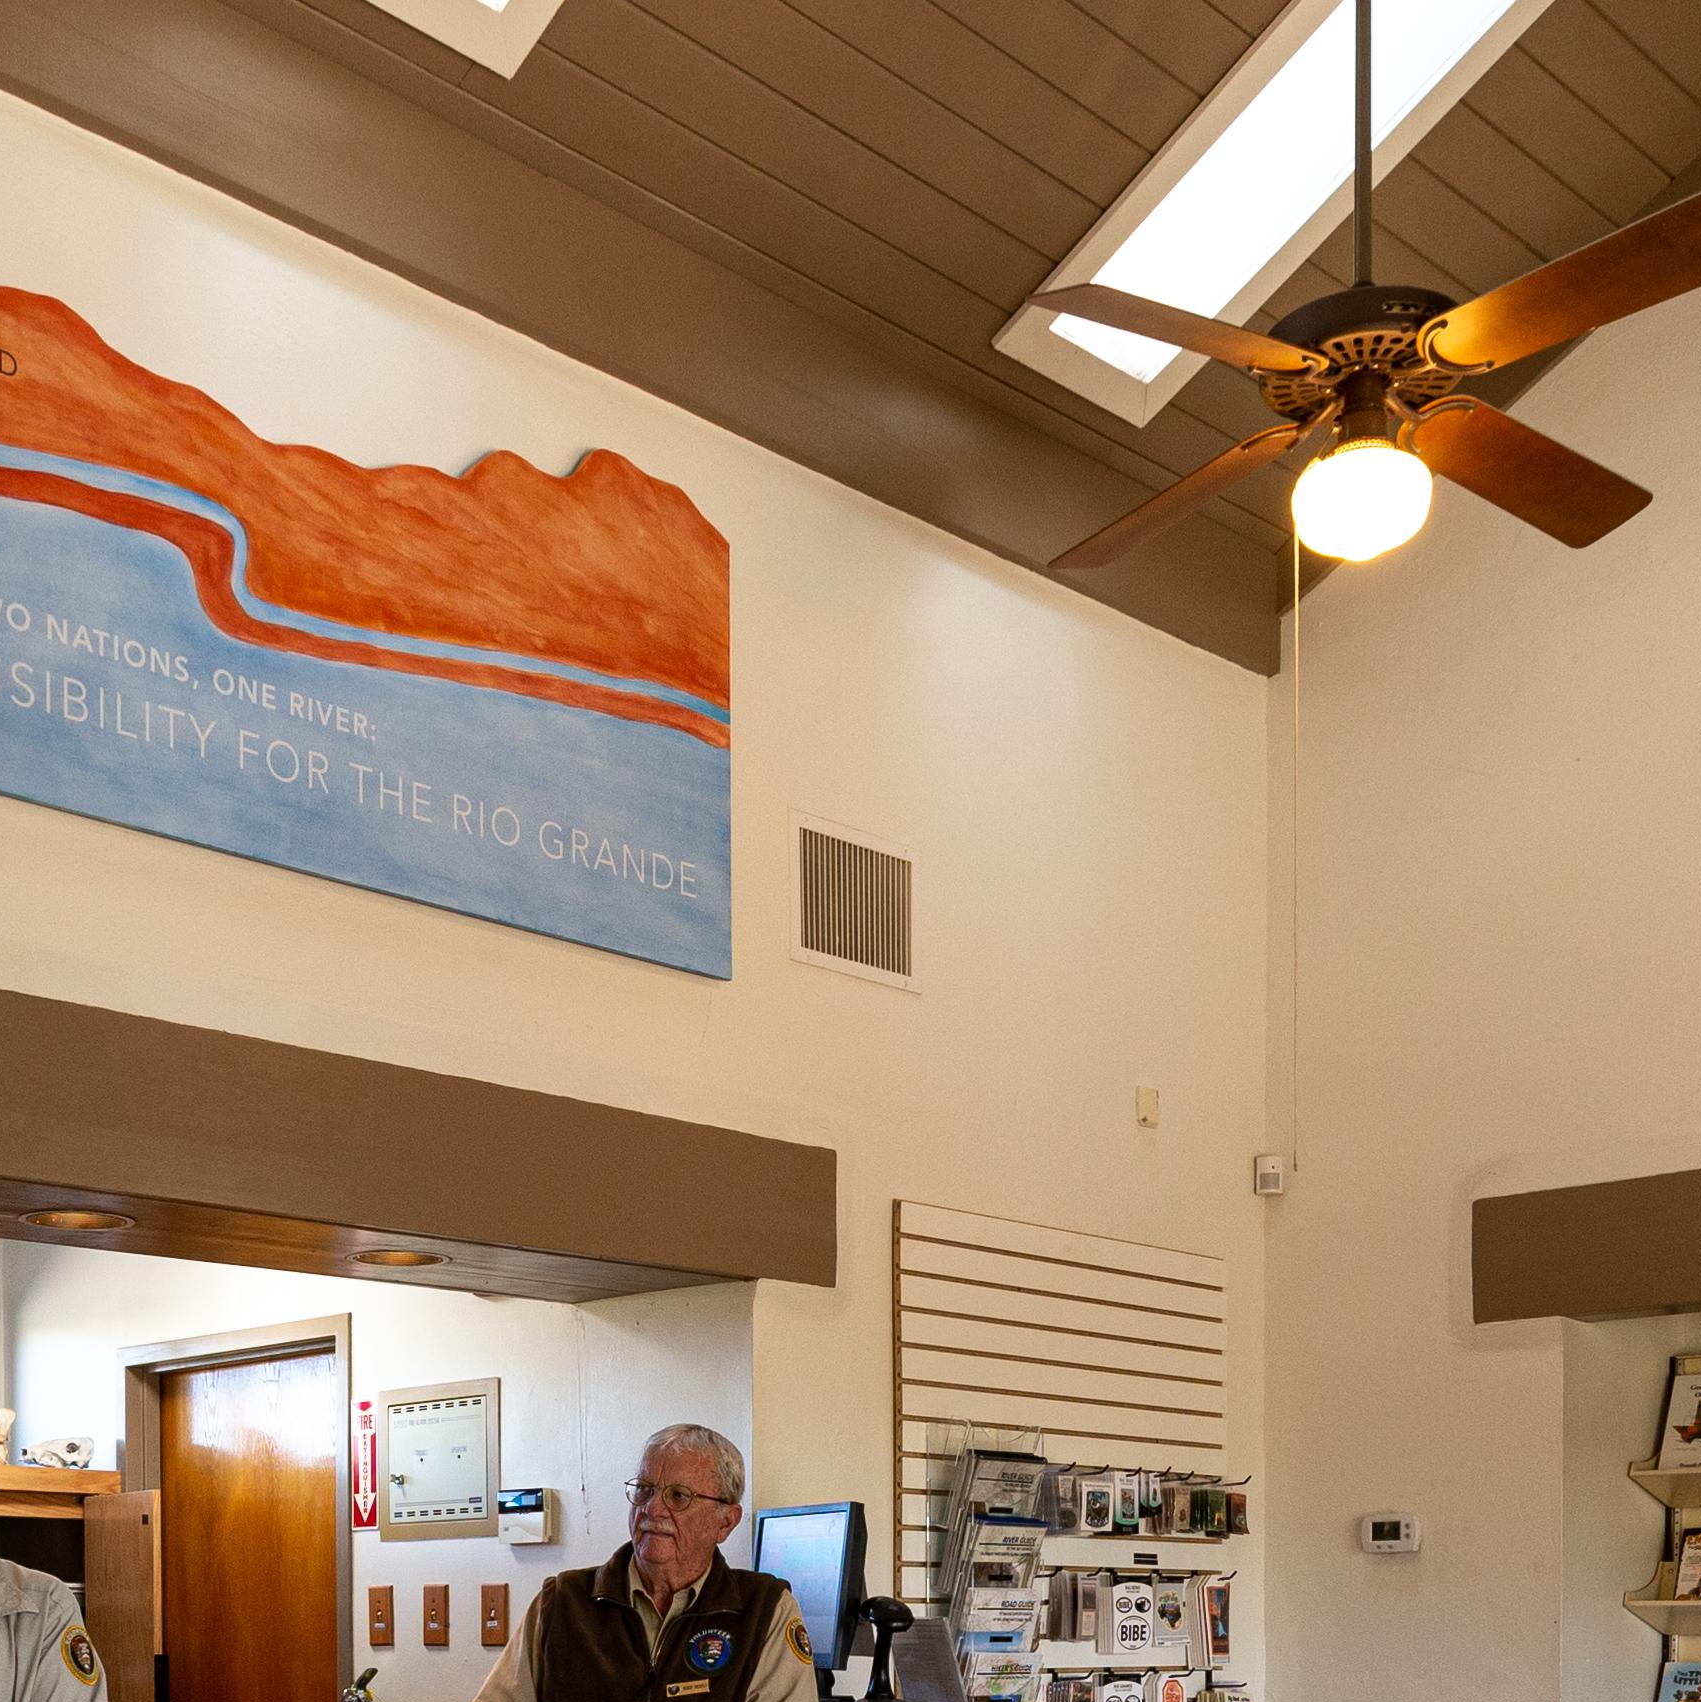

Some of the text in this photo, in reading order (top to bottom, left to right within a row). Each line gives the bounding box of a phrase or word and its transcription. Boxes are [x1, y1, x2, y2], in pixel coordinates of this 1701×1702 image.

[47, 614, 198, 689] NATIONS,
[213, 669, 277, 710] ONE
[290, 692, 377, 741] RIVER:
[239, 729, 329, 793] FOR
[349, 763, 433, 824] THE
[453, 793, 520, 846] RIO
[539, 821, 698, 899] GRANDE
[357, 1415, 373, 1430] FIRE
[689, 1629, 731, 1643] VOLUNTEER
[1120, 1624, 1147, 1642] BIBE
